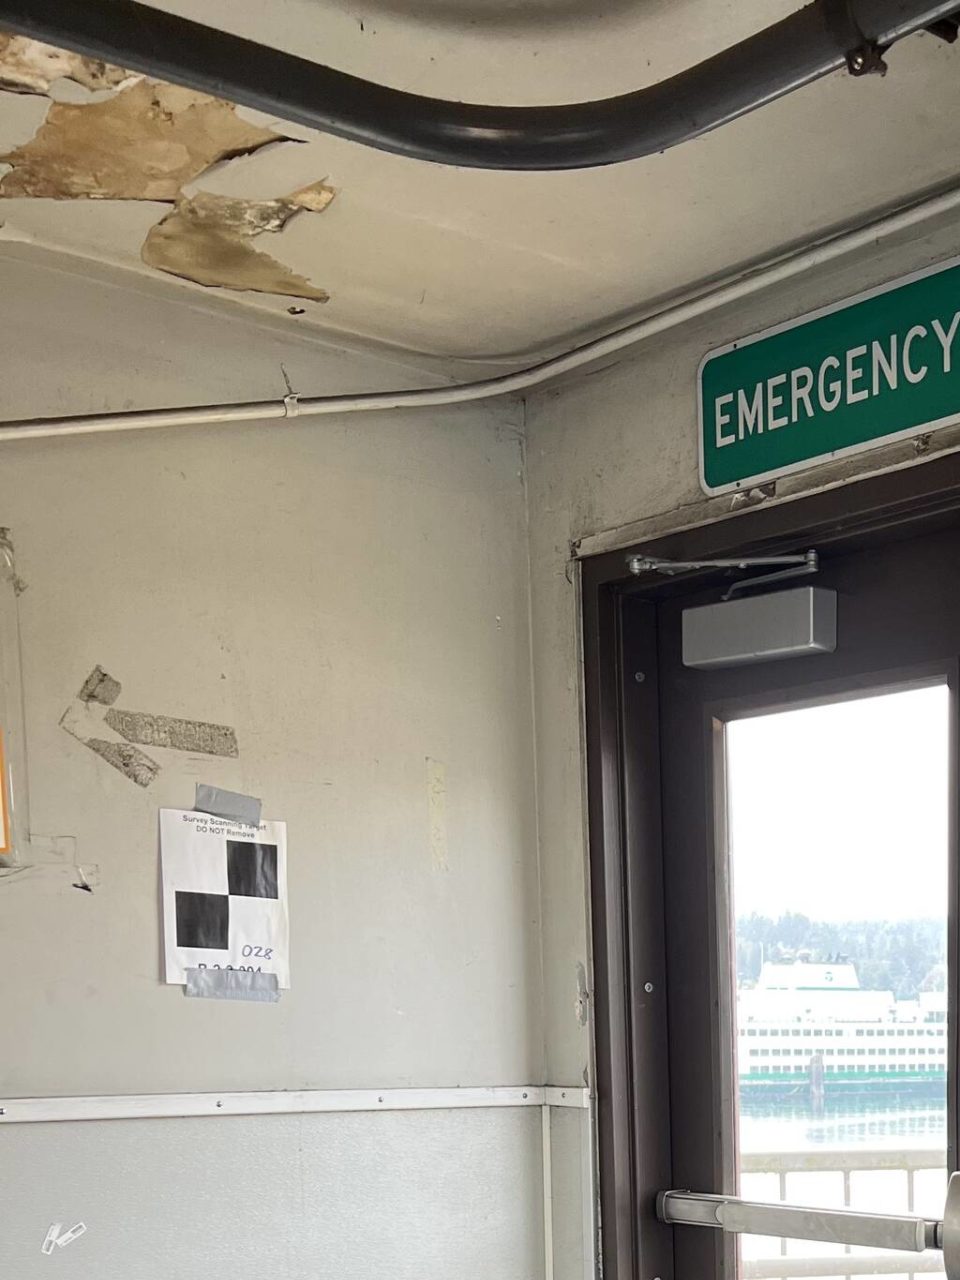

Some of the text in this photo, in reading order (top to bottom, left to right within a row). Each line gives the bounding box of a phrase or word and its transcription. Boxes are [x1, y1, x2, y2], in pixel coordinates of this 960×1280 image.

[183, 815, 208, 825] Survey
[210, 818, 243, 829] Scanning
[196, 825, 207, 833] DO
[226, 829, 255, 838] Remove
[243, 945, 273, 960] 028
